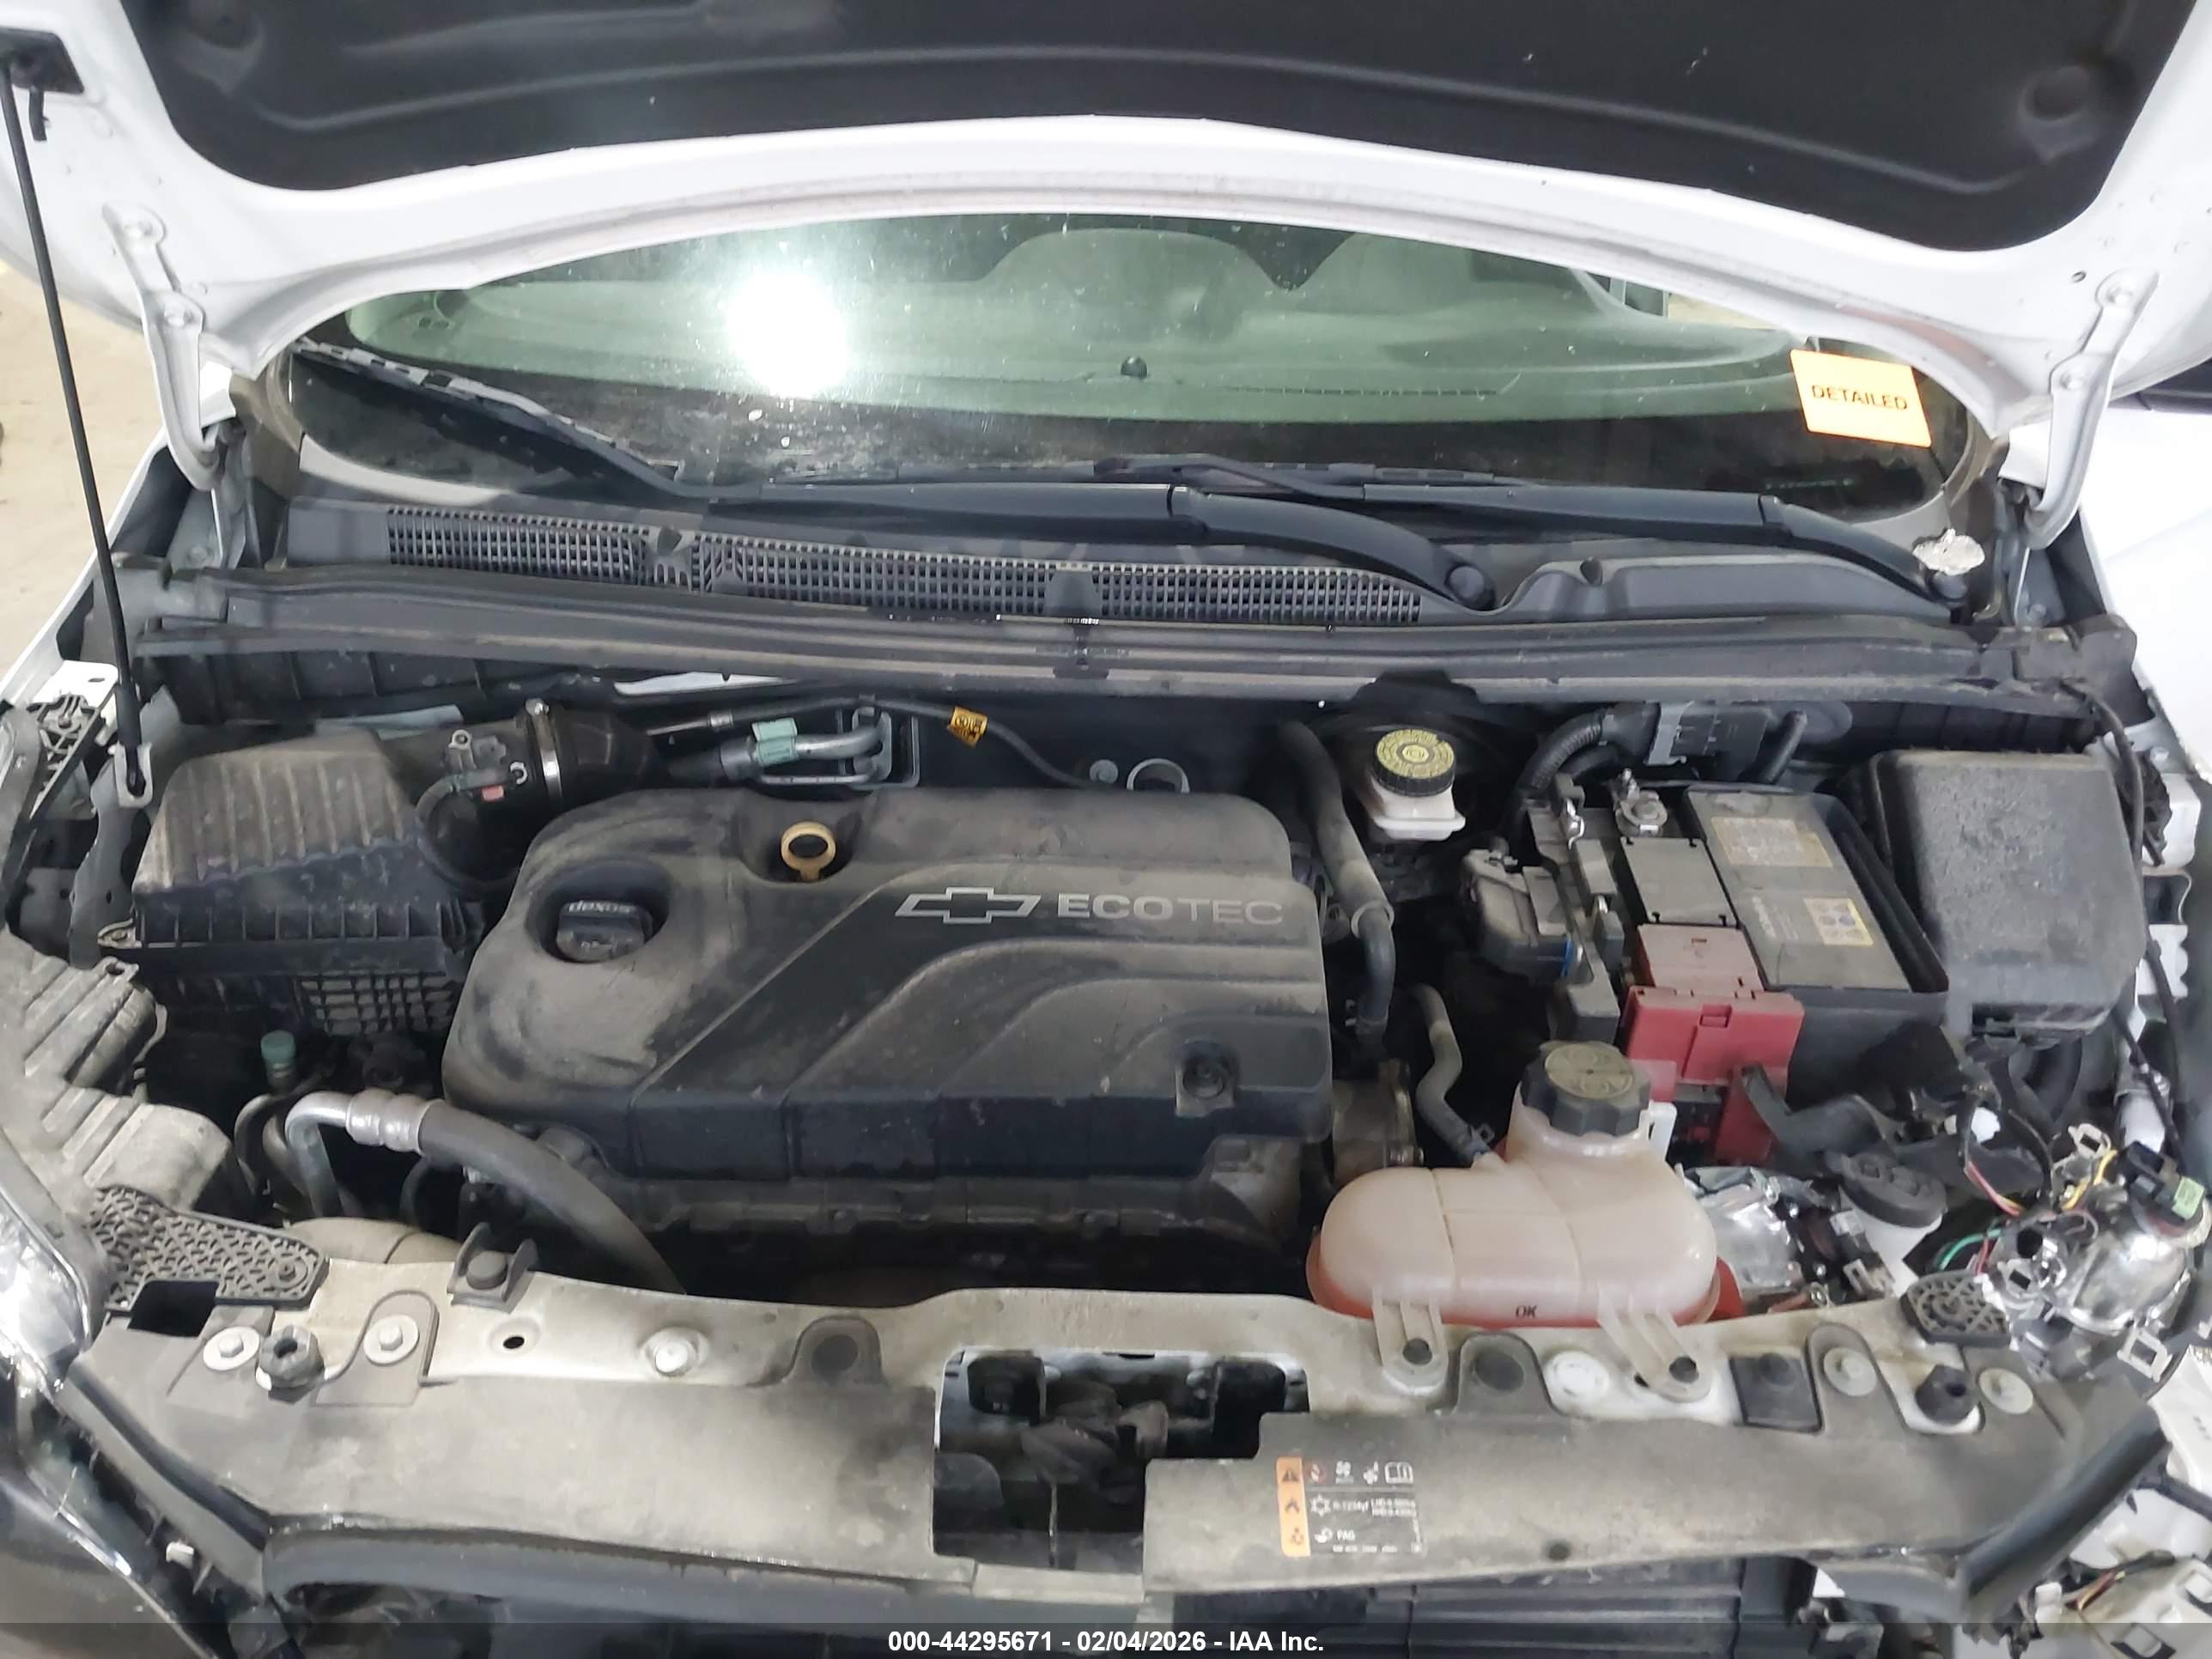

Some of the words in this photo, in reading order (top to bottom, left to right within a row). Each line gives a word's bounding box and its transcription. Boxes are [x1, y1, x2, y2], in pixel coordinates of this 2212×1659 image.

[1812, 385, 1908, 410] DETAILED
[1057, 892, 1284, 926] ECOTEC
[1515, 1304, 1538, 1320] OK
